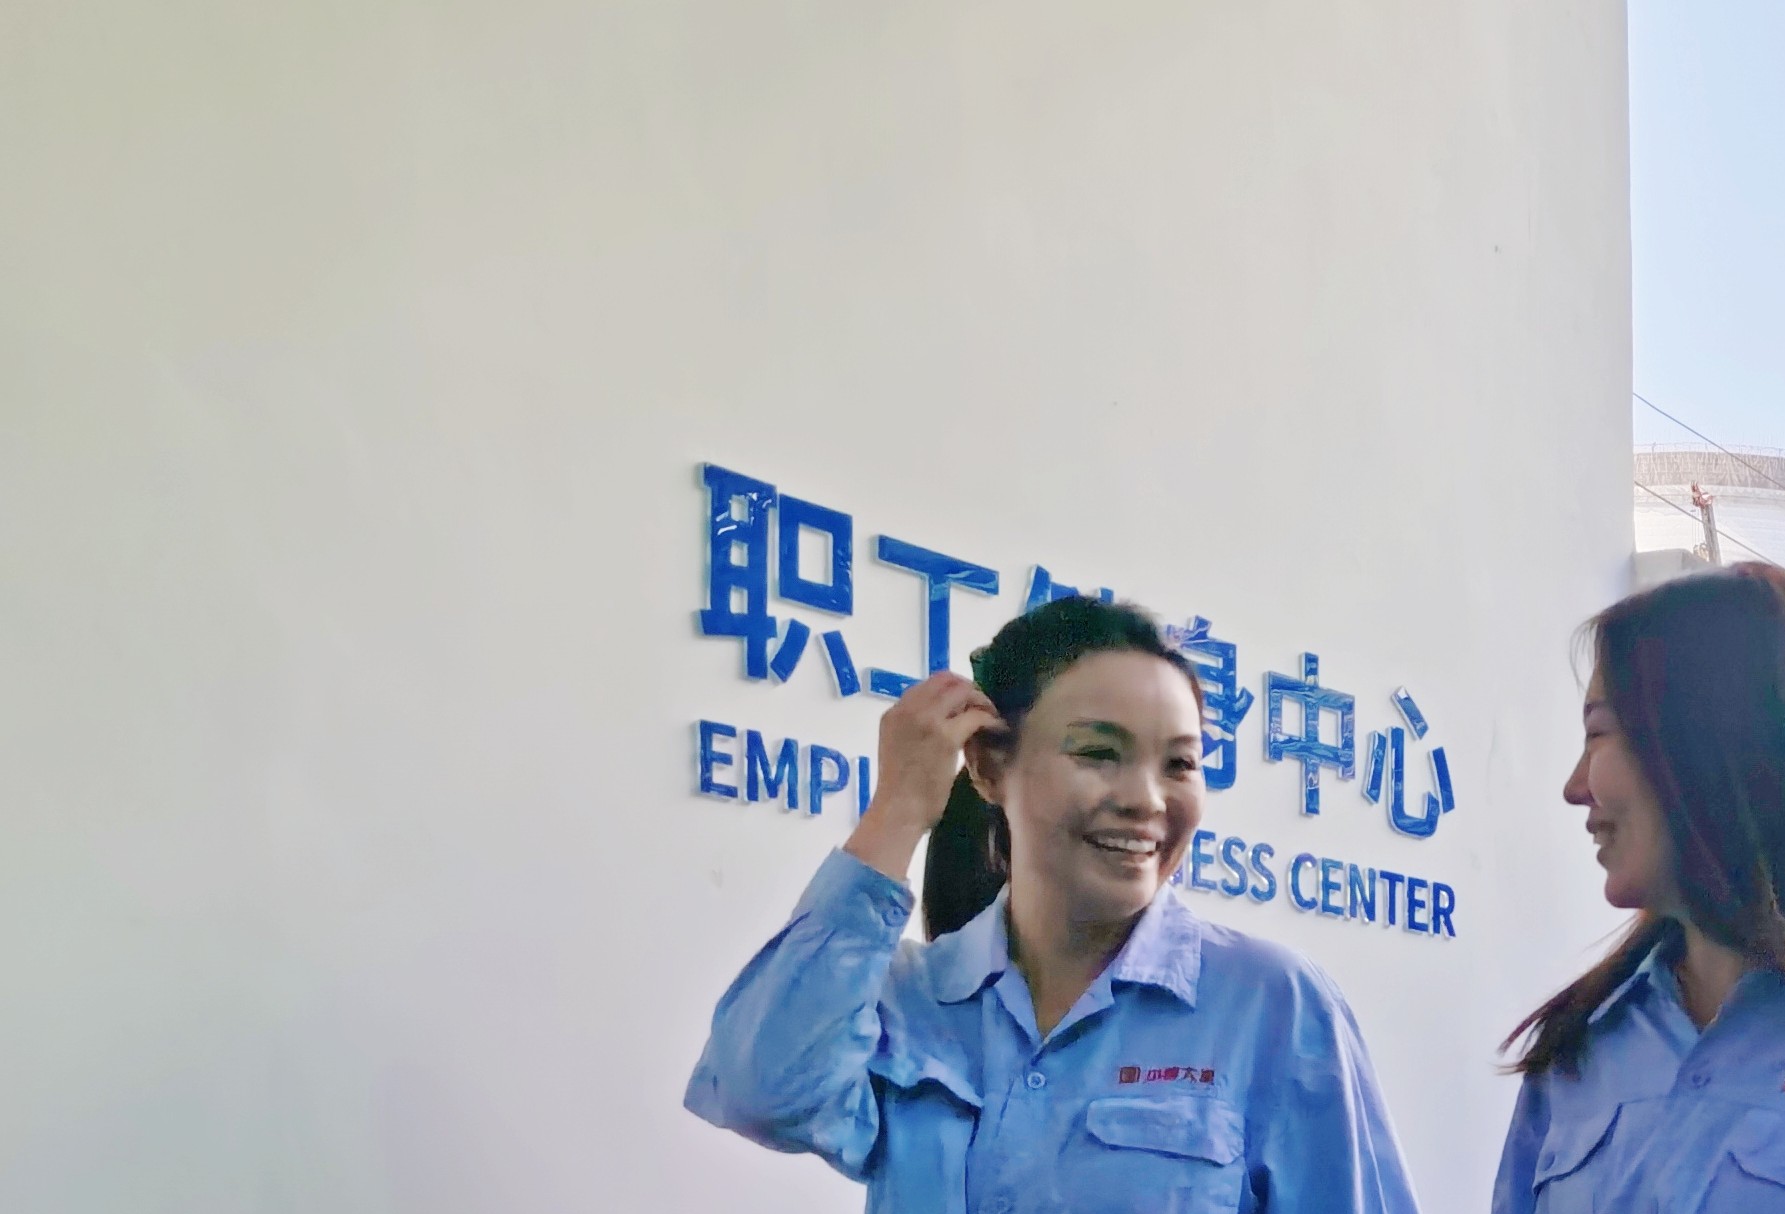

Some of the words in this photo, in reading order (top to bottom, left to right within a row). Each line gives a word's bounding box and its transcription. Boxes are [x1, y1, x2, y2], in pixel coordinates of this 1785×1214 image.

[700, 462, 1456, 839] 职工身中心
[1170, 828, 1277, 902] ESS
[1287, 852, 1456, 938] CENTER
